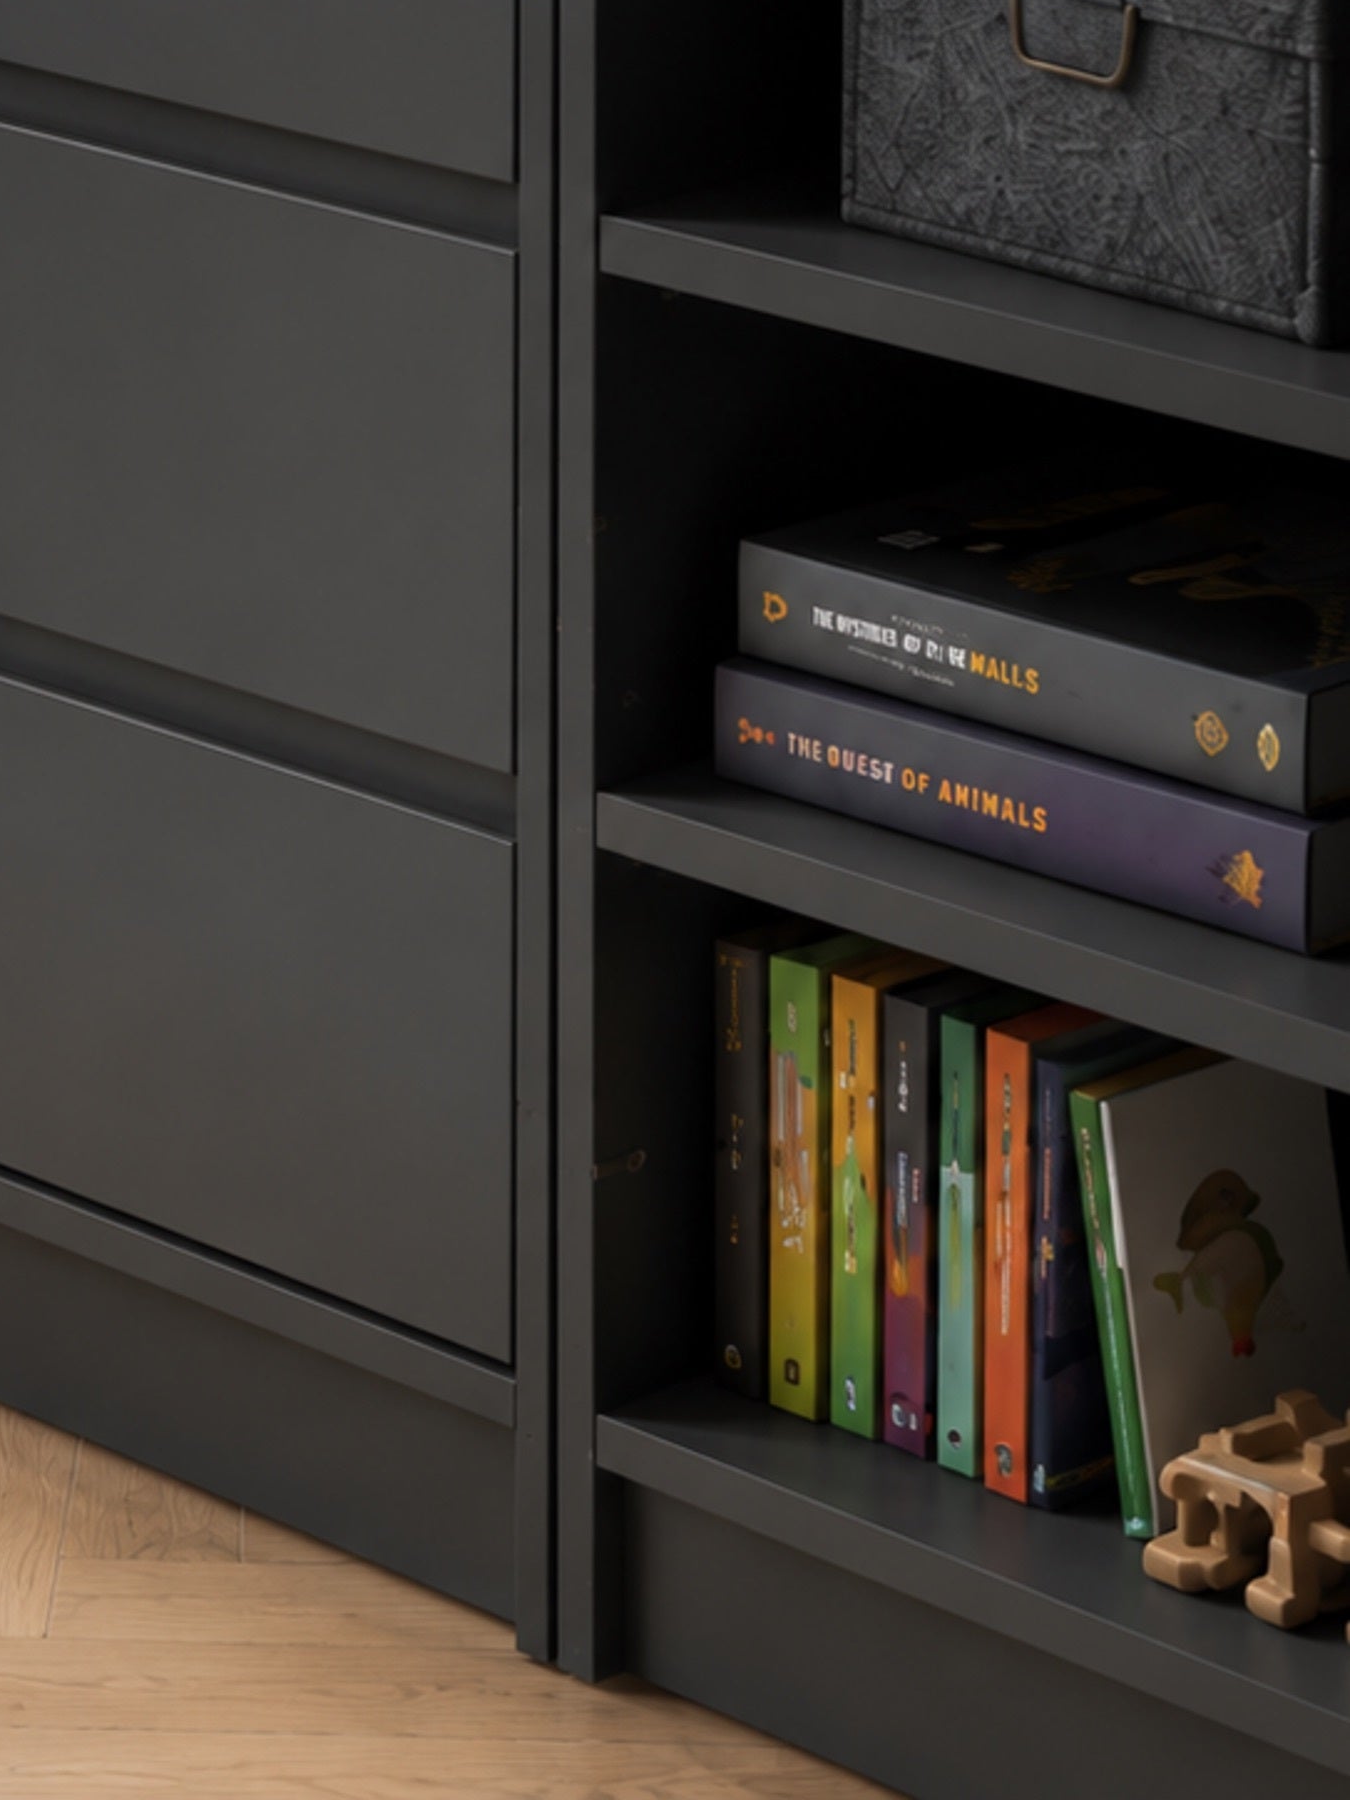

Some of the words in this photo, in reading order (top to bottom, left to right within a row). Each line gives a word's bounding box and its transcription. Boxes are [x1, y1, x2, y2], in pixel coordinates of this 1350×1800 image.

[787, 732, 823, 763] THE
[900, 767, 931, 795] OF
[937, 778, 1048, 833] ANIMALS
